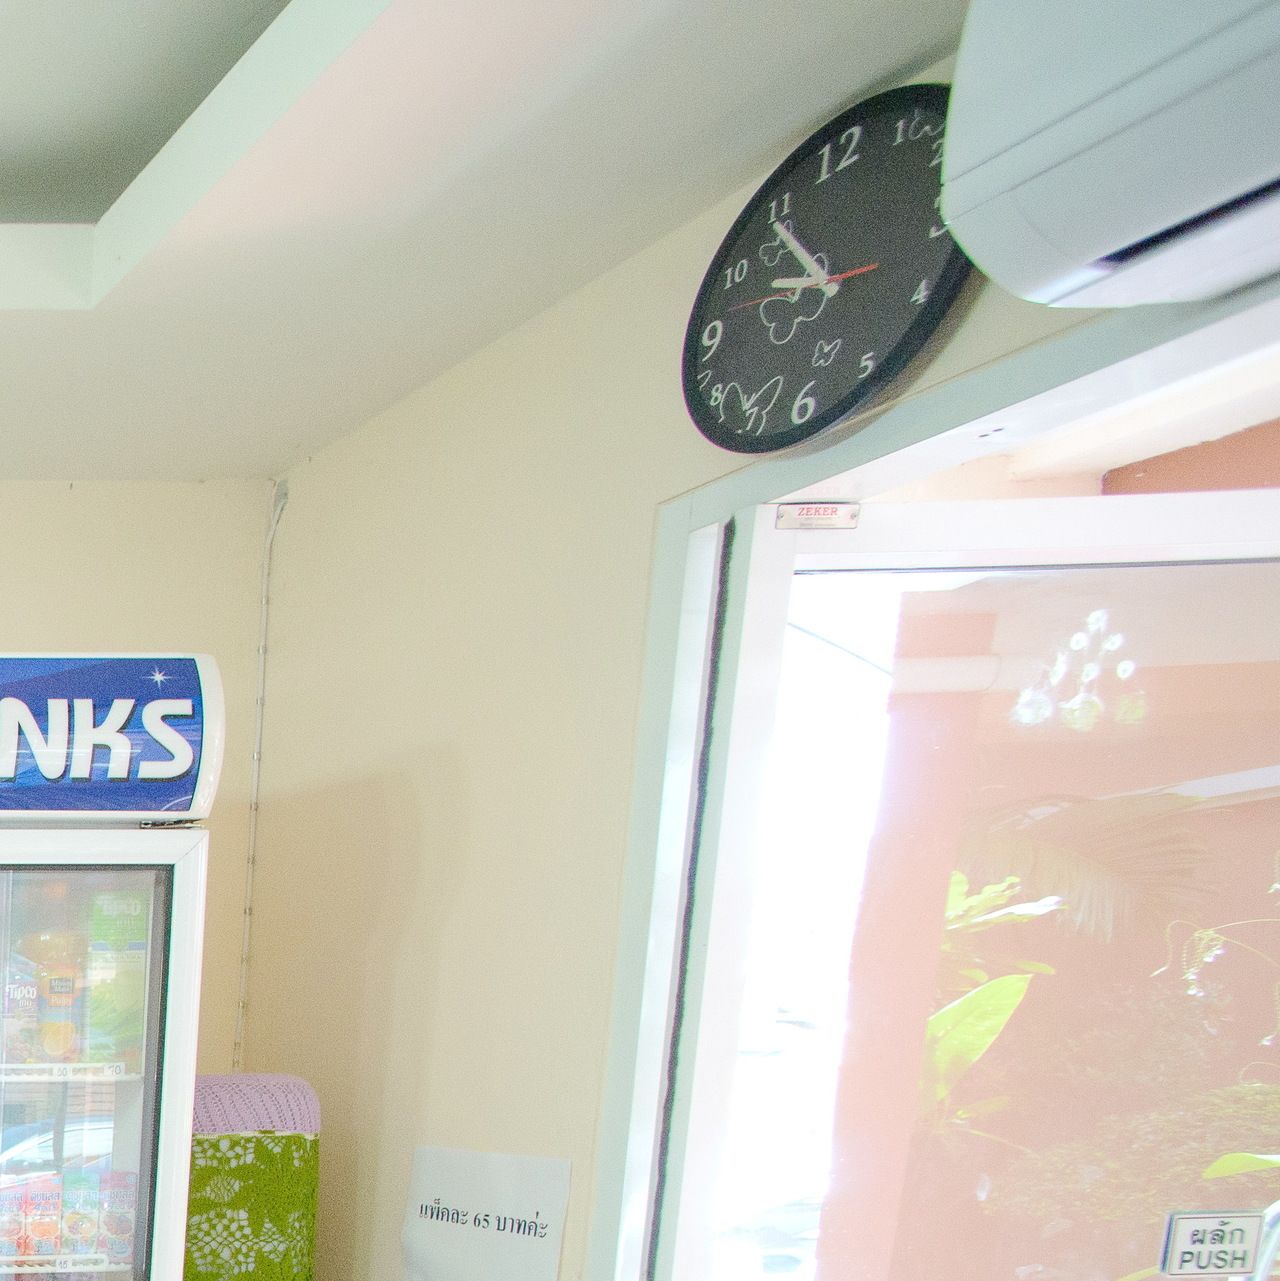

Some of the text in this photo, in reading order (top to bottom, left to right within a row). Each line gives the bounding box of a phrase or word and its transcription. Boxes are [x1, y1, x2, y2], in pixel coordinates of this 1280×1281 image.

[815, 124, 863, 185] 12
[767, 191, 792, 224] 11
[723, 257, 749, 290] 10
[909, 279, 931, 306] 4
[701, 319, 724, 362] 9
[857, 351, 875, 380] 5
[709, 383, 723, 408] 8
[790, 380, 817, 426] 6
[797, 506, 839, 517] ZEKER
[6, 983, 37, 1000] Tipco
[472, 1212, 491, 1230] 65
[495, 1210, 549, 1239] บาทค่ะ
[1190, 1219, 1246, 1246] ผลัก
[1178, 1249, 1249, 1270] PUSH
